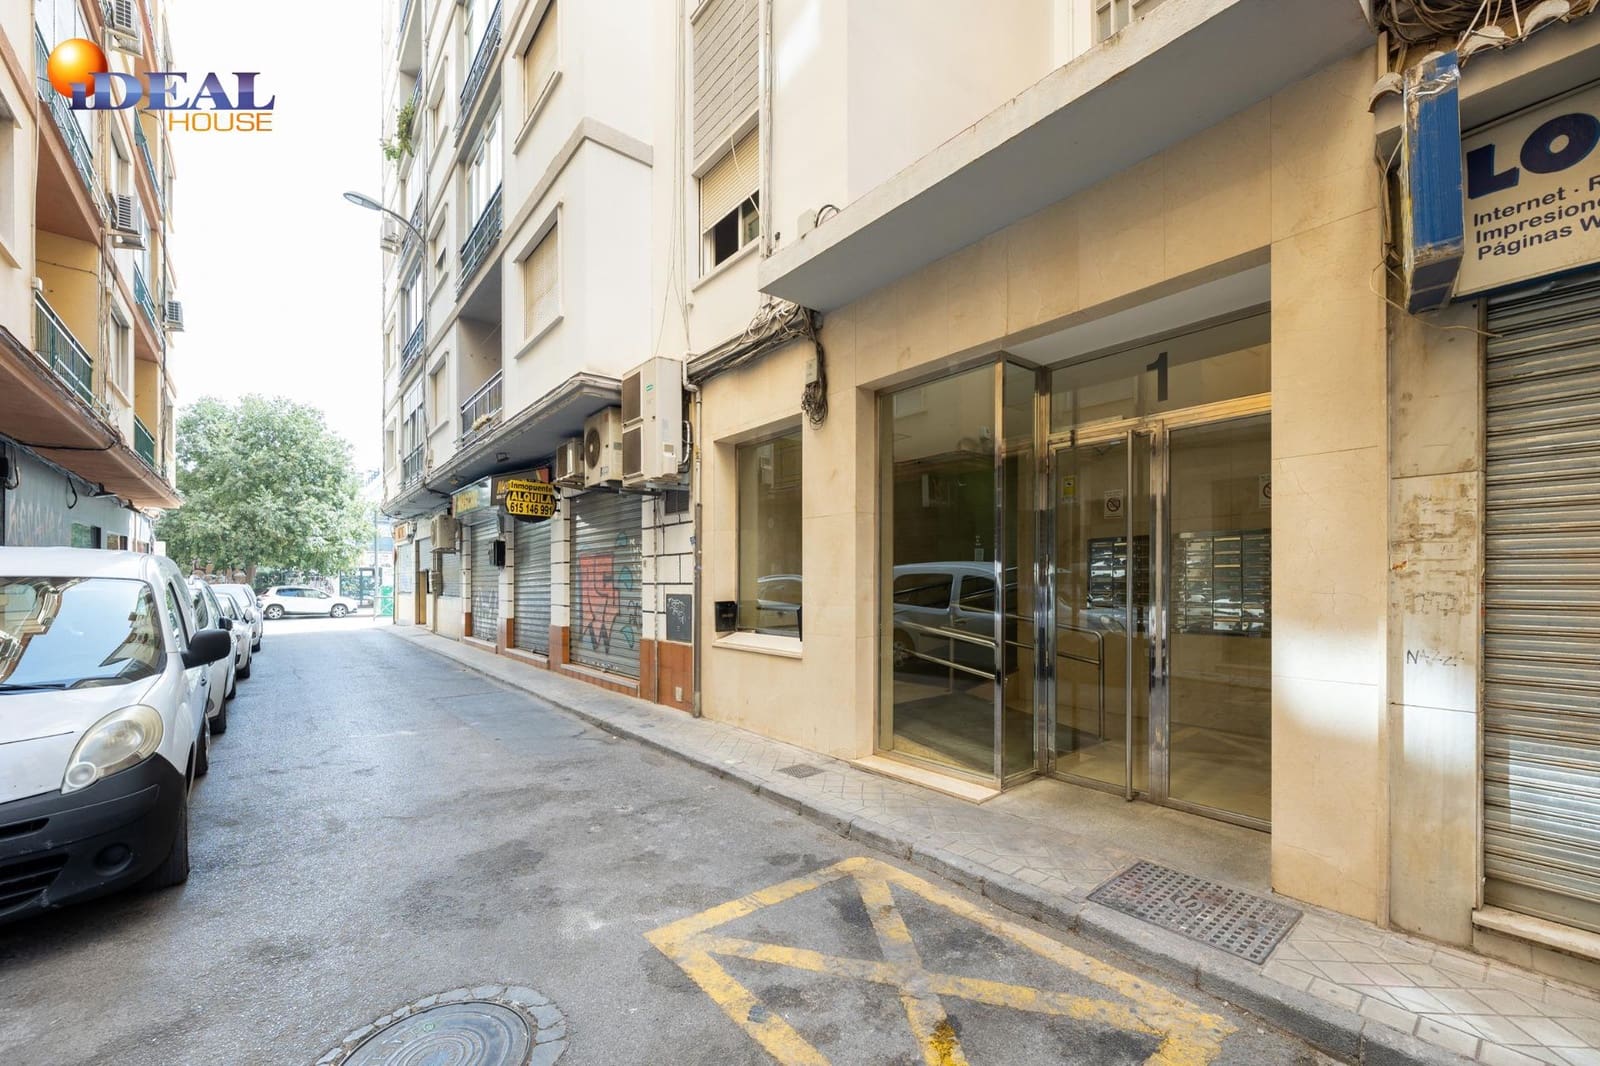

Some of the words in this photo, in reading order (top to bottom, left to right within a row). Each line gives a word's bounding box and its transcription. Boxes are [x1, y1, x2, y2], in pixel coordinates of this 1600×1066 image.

[1473, 187, 1566, 227] Internet
[1478, 225, 1572, 261] Páginas
[1146, 352, 1168, 401] 1
[510, 481, 553, 493] Inmopuente
[510, 491, 553, 504] ALQUILA
[510, 502, 524, 513] 615
[526, 503, 539, 515] 146
[540, 504, 553, 516] 991
